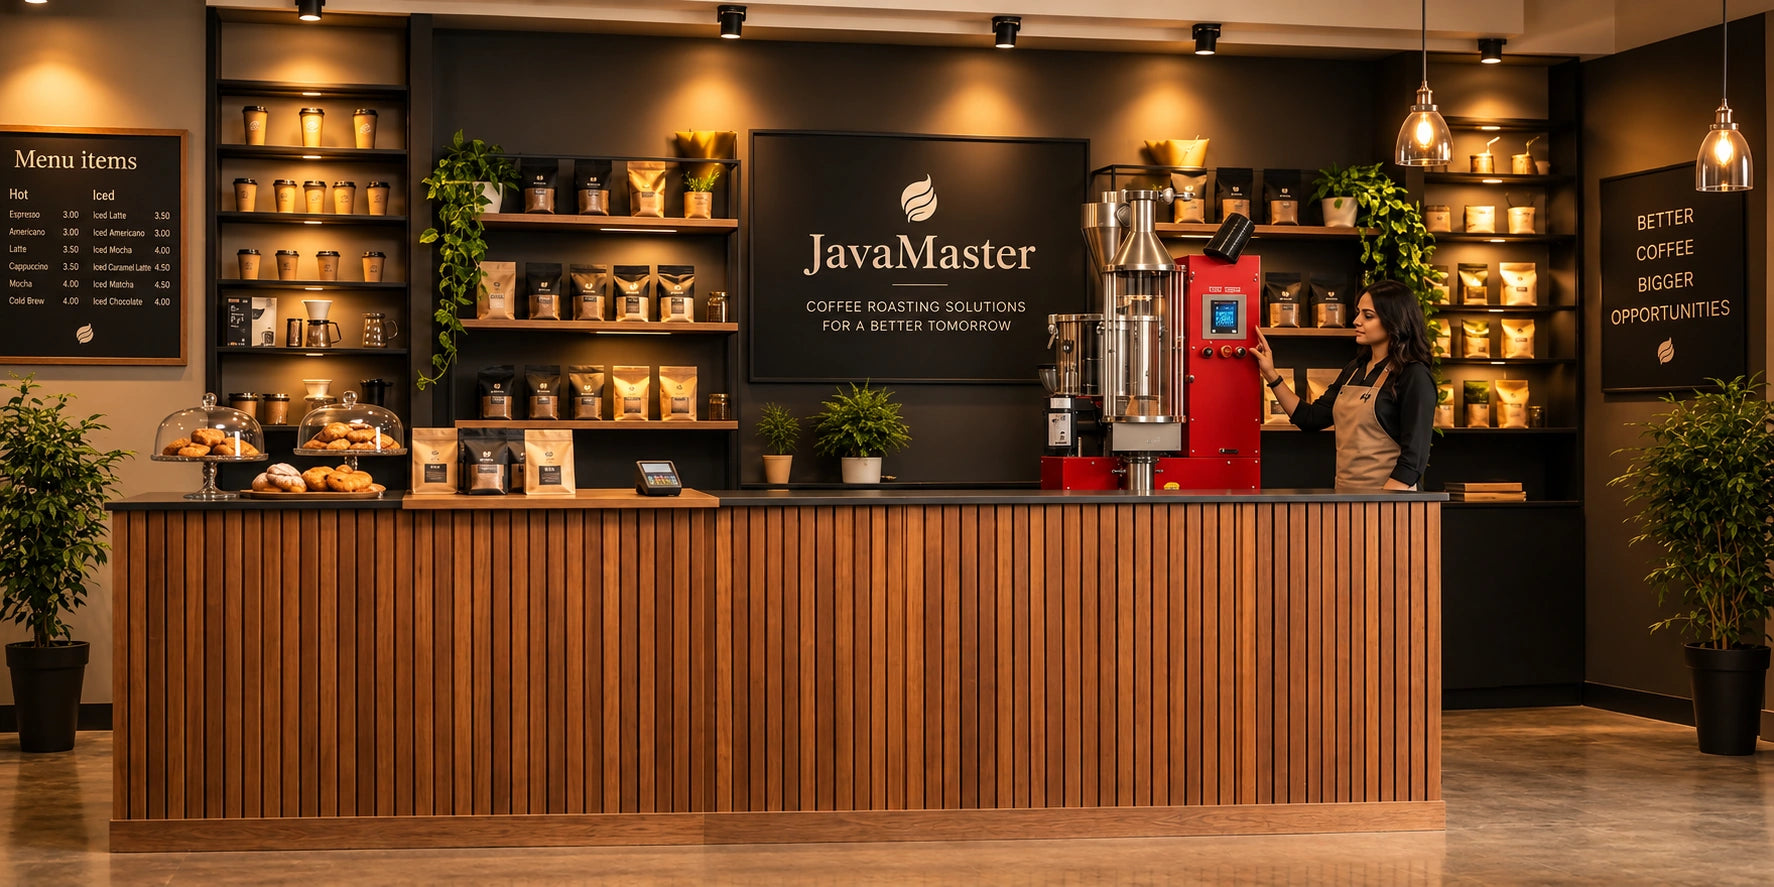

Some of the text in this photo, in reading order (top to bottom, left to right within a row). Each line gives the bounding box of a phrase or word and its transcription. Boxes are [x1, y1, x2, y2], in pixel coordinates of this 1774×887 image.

[15, 150, 136, 169] Menu items
[10, 188, 28, 199] Hot
[93, 190, 114, 200] Iced
[10, 210, 79, 219] Espresso 3.00
[93, 210, 170, 220] Iced Latte 3.50
[1638, 208, 1693, 230] BETTER
[9, 227, 79, 236] Americano 3.00
[93, 228, 170, 237] Iced Americano 3.00
[10, 244, 79, 254] Latte 3.50
[93, 245, 170, 255] Iced Mocha 4.00
[1637, 239, 1693, 261] COFFEE
[804, 234, 1036, 275] JavaMaster
[9, 262, 79, 271] Cappuccino 3.50
[93, 263, 170, 272] Iced Caramel Latte 4.50
[10, 279, 79, 288] Mocha 4.00
[93, 280, 170, 289] Iced Matcha 4.50
[1639, 272, 1693, 292] BIGGER
[9, 296, 79, 305] Cold Brew 4.00
[93, 296, 170, 306] Iced Chocolate 4.00
[807, 301, 1025, 312] COFFEE ROASTING SOLUTIONS
[1611, 300, 1729, 325] OPPORTUNITIES
[823, 320, 1011, 331] FOR A BETTER TOMORROW
